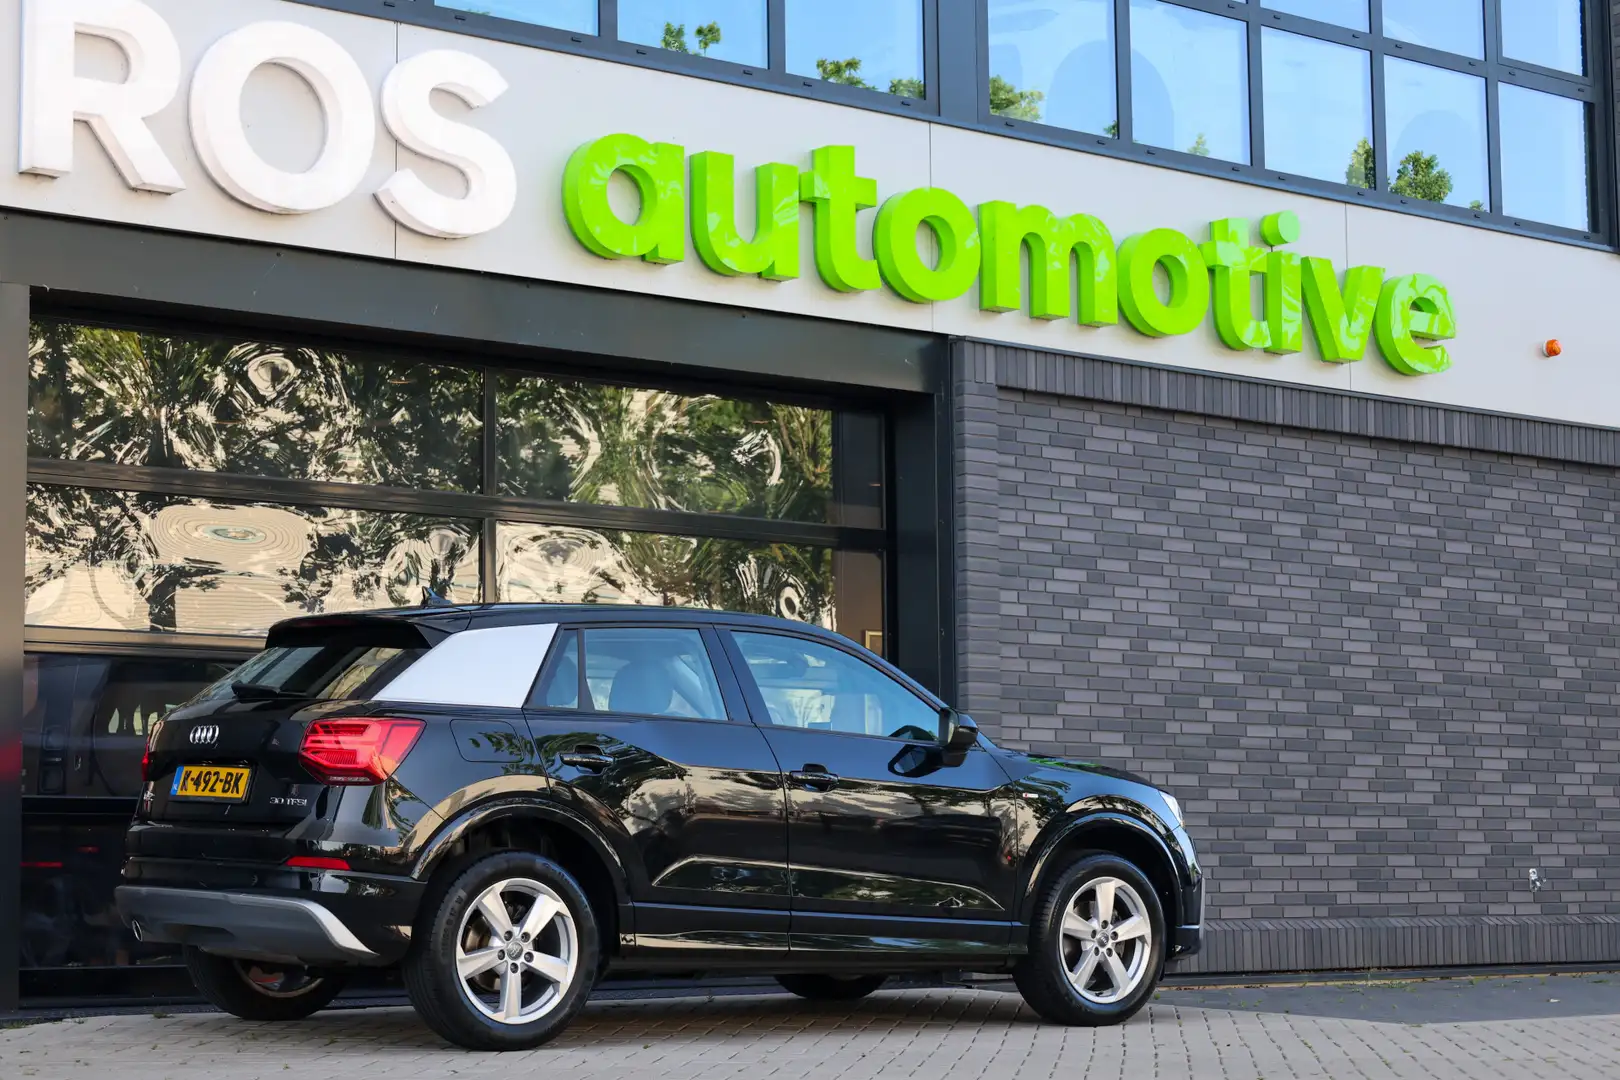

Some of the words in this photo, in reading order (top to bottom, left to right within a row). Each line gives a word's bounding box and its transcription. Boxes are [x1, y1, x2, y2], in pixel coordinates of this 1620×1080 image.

[18, 0, 517, 239] ROS
[562, 132, 1456, 375] automotive
[180, 770, 244, 795] K-492-BK
